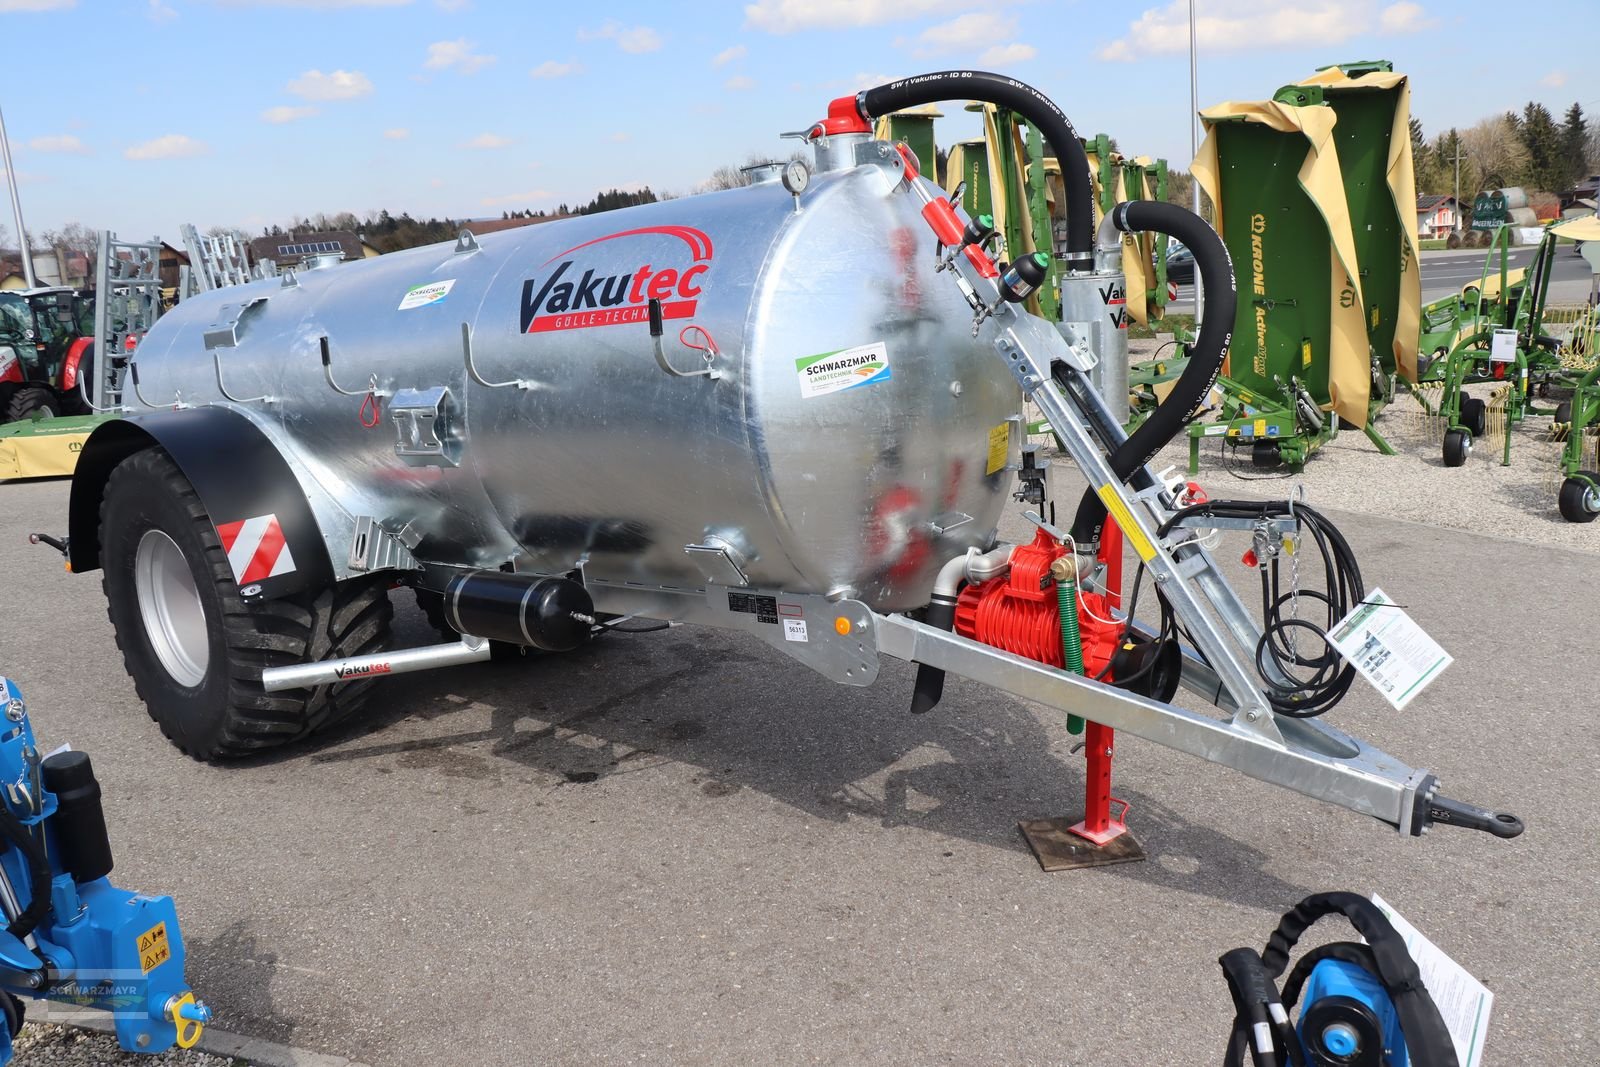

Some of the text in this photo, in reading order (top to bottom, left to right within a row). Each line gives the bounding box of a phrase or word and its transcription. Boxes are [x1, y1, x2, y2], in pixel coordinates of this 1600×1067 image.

[890, 80, 904, 90] SW
[910, 74, 942, 84] Vakutec
[1009, 79, 1025, 89] SW
[1251, 233, 1265, 296] KRONE
[520, 260, 710, 334] Vakutec
[806, 353, 877, 376] SCHWARZMAYR
[809, 369, 853, 384] LANDTECHNIK
[1196, 366, 1220, 402] Vakutec
[334, 662, 391, 679] Vakutec
